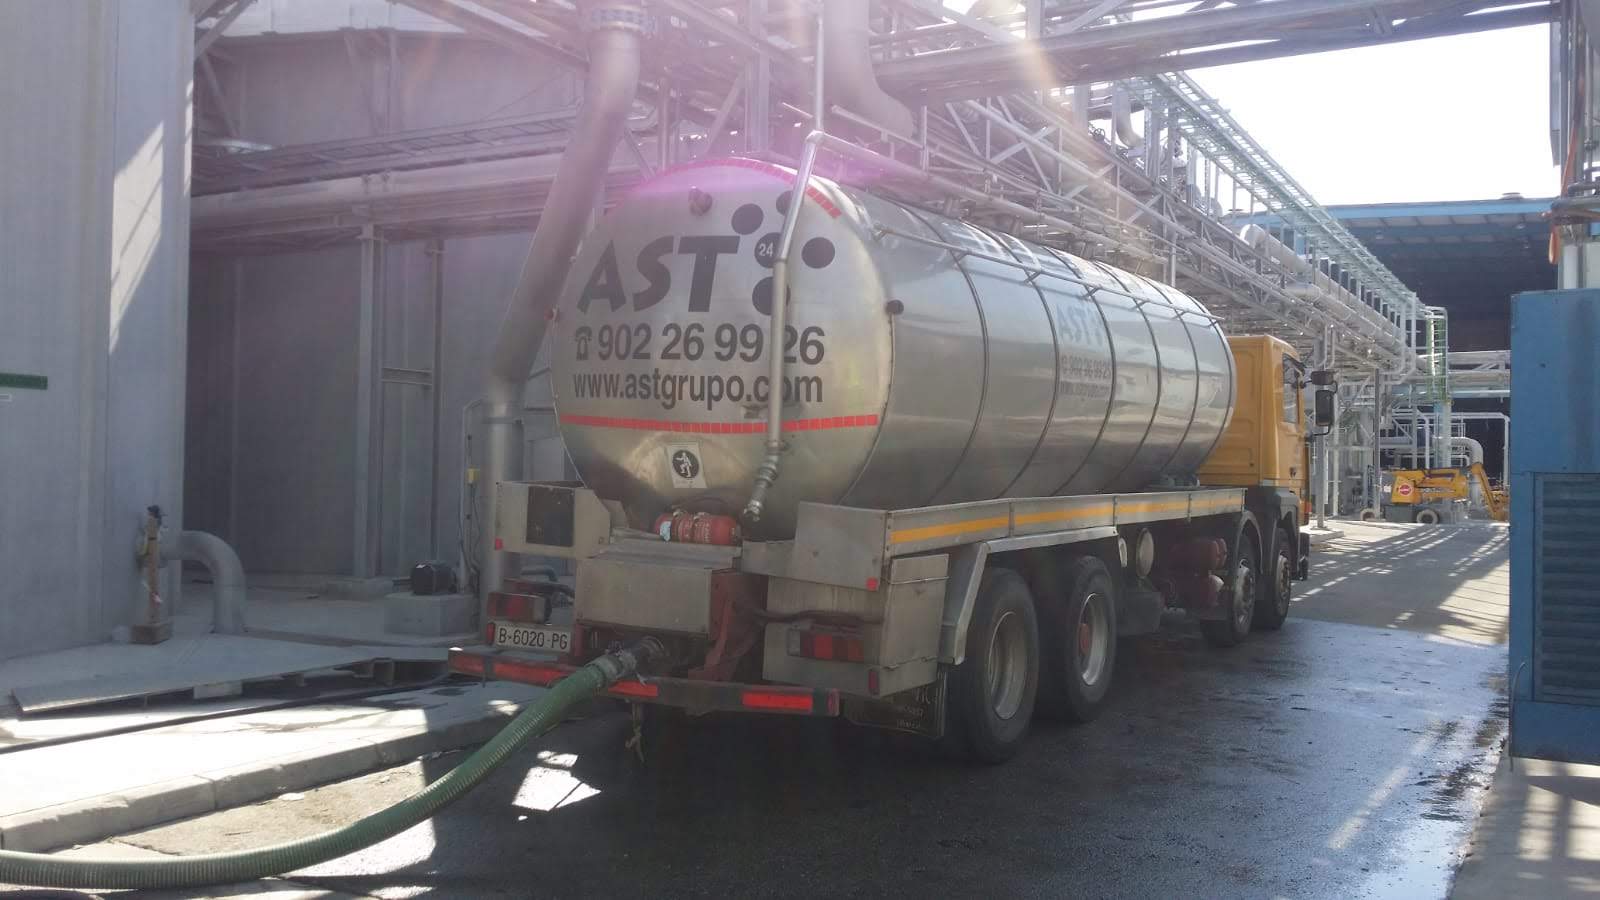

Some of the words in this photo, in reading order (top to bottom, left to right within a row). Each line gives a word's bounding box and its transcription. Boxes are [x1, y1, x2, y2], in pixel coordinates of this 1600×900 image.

[759, 243, 775, 257] 24
[577, 235, 741, 314] AST
[598, 326, 652, 361] 902
[660, 323, 705, 361] 26
[714, 322, 764, 363] 99
[784, 324, 825, 365] 26
[499, 627, 568, 650] B-6020-PG
